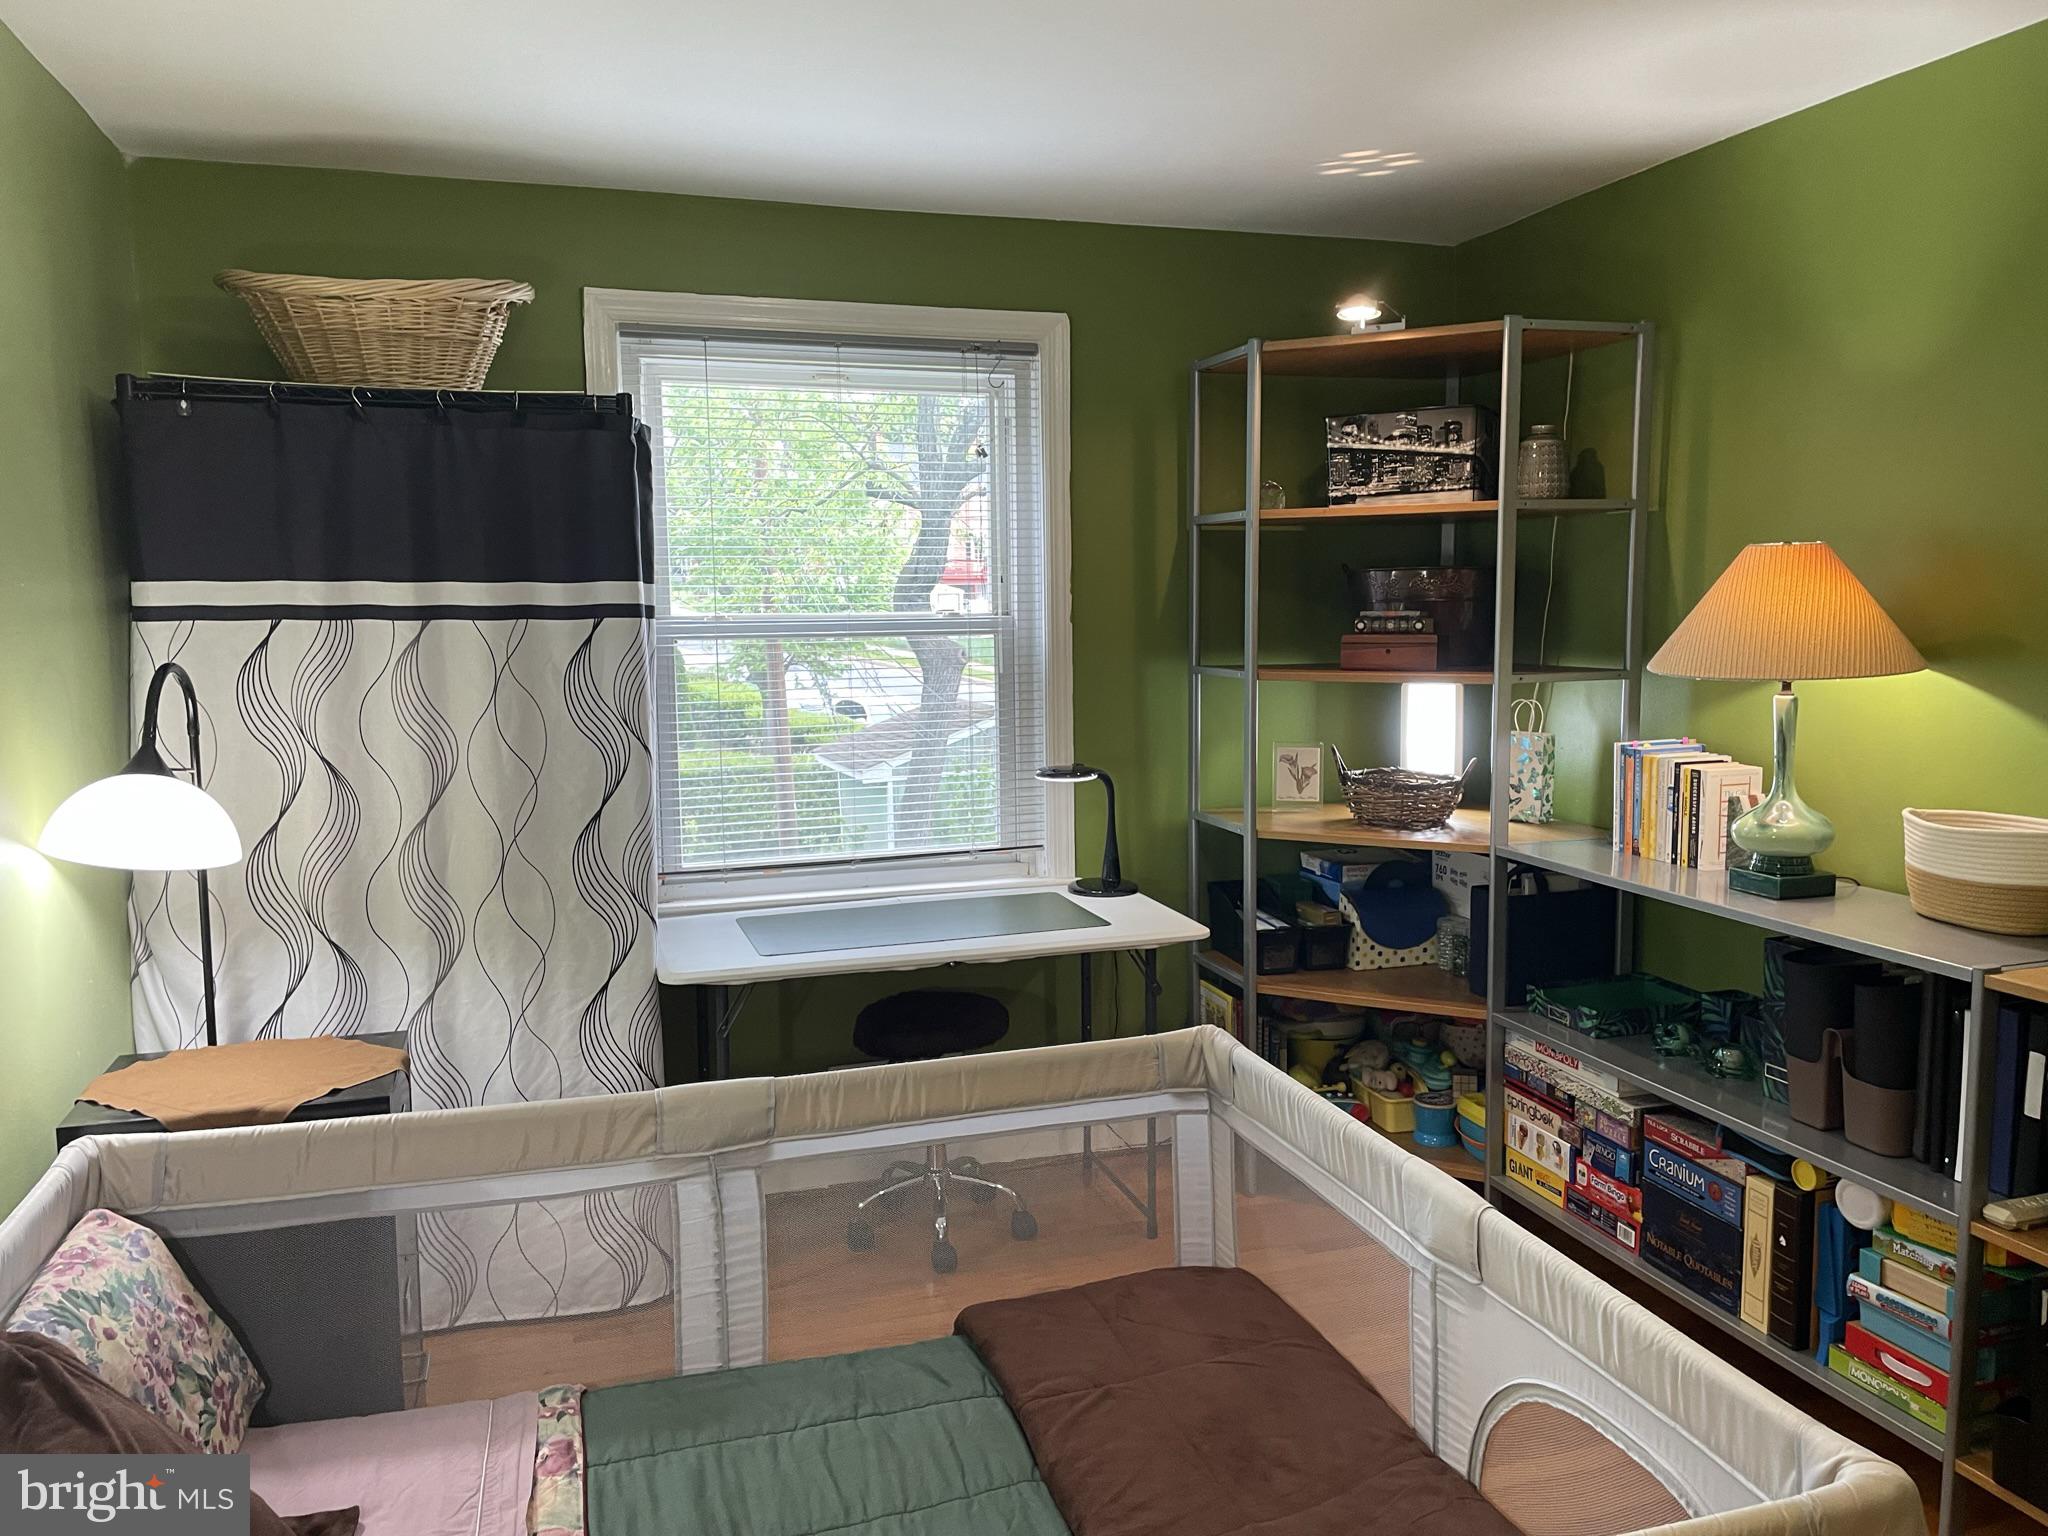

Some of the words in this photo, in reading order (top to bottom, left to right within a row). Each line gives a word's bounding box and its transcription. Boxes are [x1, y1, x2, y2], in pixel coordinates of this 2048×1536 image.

[1536, 1041, 1579, 1070] MONOPOLY
[1595, 1142, 1617, 1162] BINGO
[1670, 1132, 1706, 1156] SCRABBLE
[1509, 1158, 1534, 1182] GIANT
[1591, 1175, 1607, 1191] Farm
[1607, 1183, 1626, 1201] Bingo
[1646, 1231, 1683, 1261] NOTABLE
[1683, 1253, 1735, 1290] QUOTABLES
[1892, 1242, 1935, 1271] Matching
